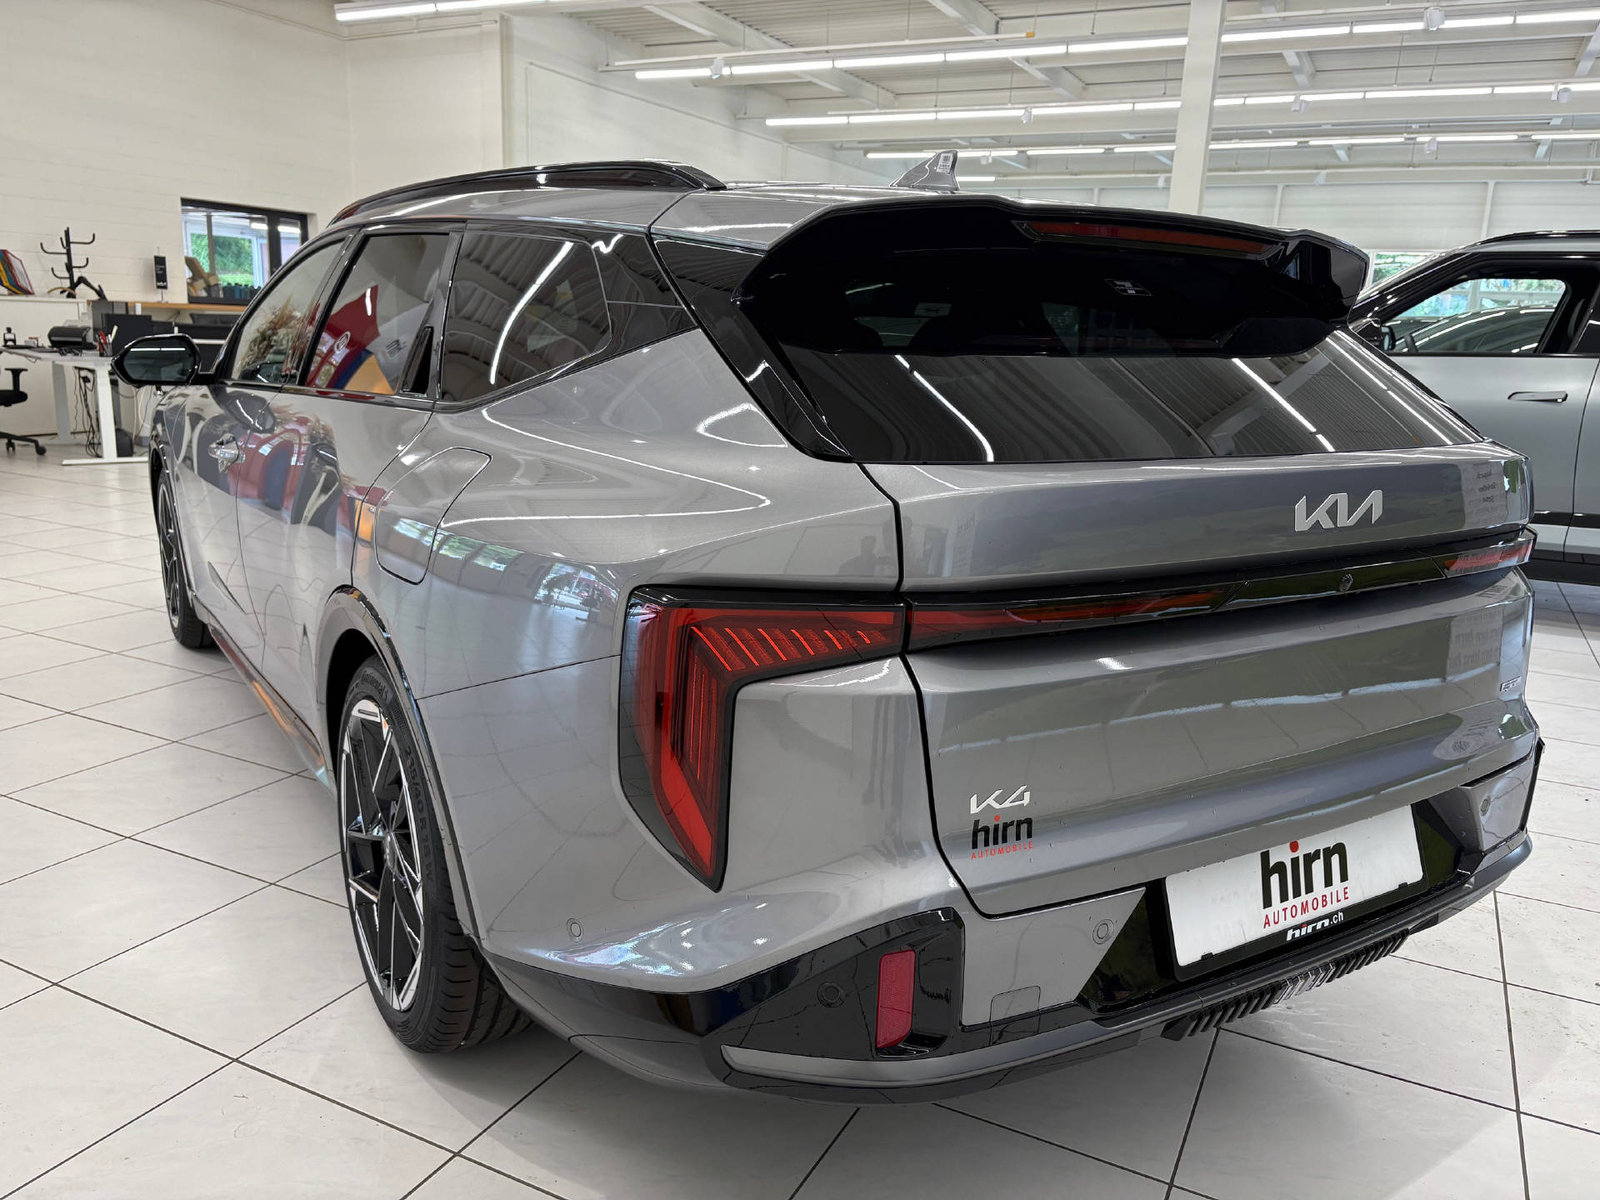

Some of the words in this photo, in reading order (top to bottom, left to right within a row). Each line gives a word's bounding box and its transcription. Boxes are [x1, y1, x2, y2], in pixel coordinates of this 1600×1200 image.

[1295, 490, 1383, 532] KIA
[970, 785, 1031, 814] K4
[971, 814, 1033, 850] hirn
[971, 841, 1033, 860] AUTOMOBILE
[1260, 840, 1349, 910] hirn
[1263, 886, 1350, 929] AUTOMOBILE
[1286, 911, 1344, 942] hirn.ch
